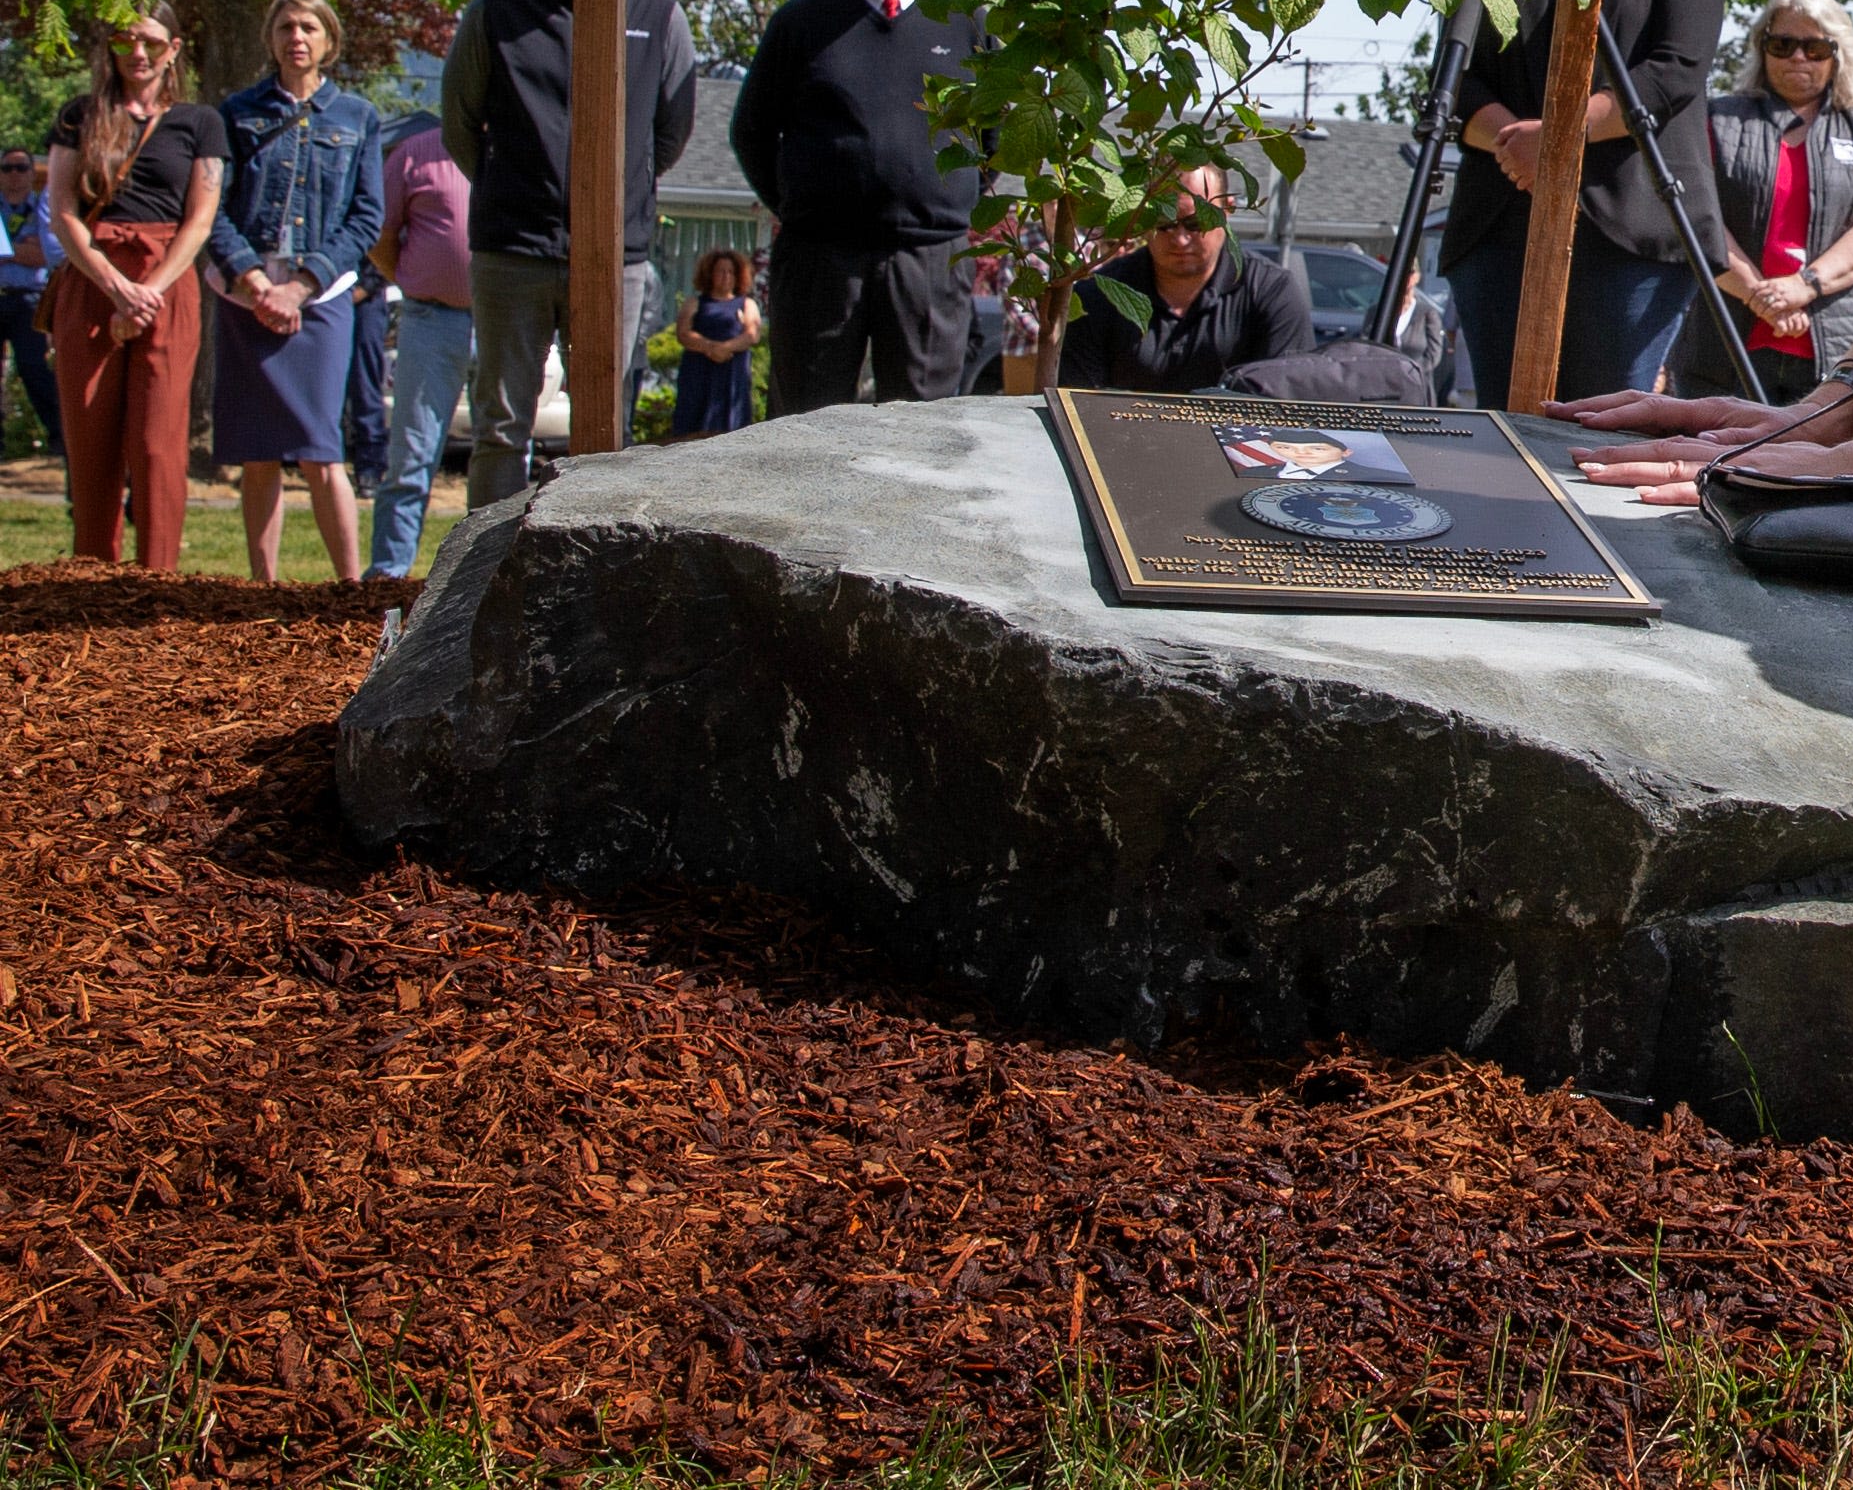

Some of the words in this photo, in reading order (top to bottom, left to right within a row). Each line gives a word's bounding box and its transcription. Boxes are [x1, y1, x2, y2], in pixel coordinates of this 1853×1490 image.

[1130, 401, 1204, 410] Airman
[1211, 405, 1277, 413] Trinity
[1357, 413, 1442, 422] Reinhart
[1178, 409, 1242, 417] United
[1209, 400, 1274, 408] Loving
[1280, 404, 1357, 412] Memory
[1109, 411, 1153, 419] 90th
[1159, 414, 1226, 422] Missile
[1232, 417, 1312, 426] Security
[1317, 421, 1377, 430] Forces
[1381, 425, 1473, 435] Squadron
[1258, 486, 1325, 504] UNITED
[1353, 488, 1425, 509] STATES
[1286, 519, 1325, 532] AIR
[1352, 524, 1425, 536] FORCE
[1184, 535, 1295, 545] November
[1338, 541, 1387, 549] 2003
[1405, 544, 1459, 552] Sept.
[1499, 548, 1547, 556] 2023
[1216, 543, 1300, 553] Airman
[1307, 547, 1403, 557] Reinhart
[1408, 551, 1448, 559] lost
[1452, 553, 1486, 561] her
[1490, 554, 1526, 562] life
[1140, 555, 1200, 564] while
[1205, 557, 1232, 565] on
[1237, 559, 1287, 568] duty
[1292, 561, 1315, 569] in
[1321, 562, 1334, 570] a
[1339, 563, 1428, 573] Humvee
[1433, 567, 1518, 577] rollover
[1522, 570, 1616, 581] accident.
[1270, 553, 1346, 563] service
[1352, 556, 1374, 564] to
[1380, 557, 1417, 566] her
[1153, 562, 1196, 571] Her
[1201, 564, 1238, 573] life
[1244, 566, 1285, 575] and
[1290, 568, 1384, 579] sacrifice
[1389, 572, 1430, 581] will
[1436, 574, 1472, 582] not
[1476, 575, 1502, 584] be
[1505, 577, 1611, 588] forgotten.
[1261, 574, 1369, 585] Dedicated
[1374, 579, 1425, 588] May
[1469, 583, 1519, 591] 2024
